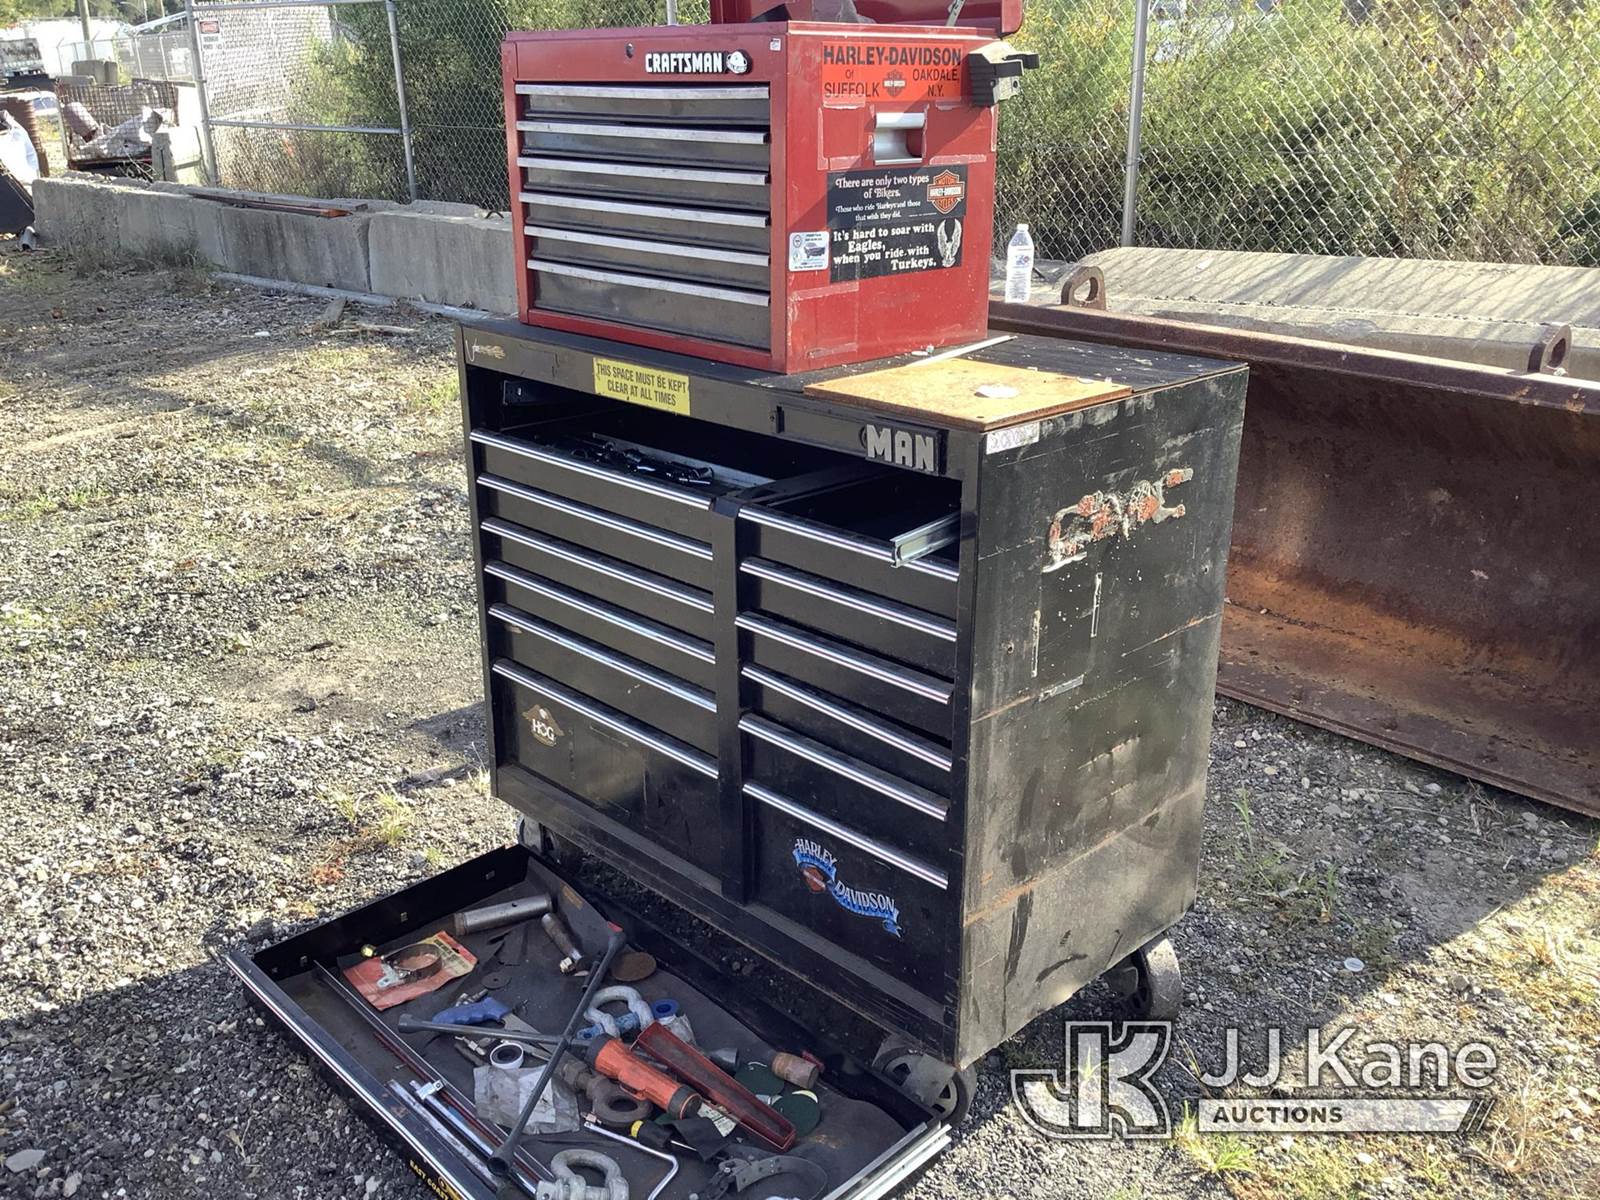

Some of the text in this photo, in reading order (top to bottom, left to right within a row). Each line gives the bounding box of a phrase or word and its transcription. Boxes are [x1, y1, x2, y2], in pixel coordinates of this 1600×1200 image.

[645, 52, 723, 73] CRAFTSMAN
[823, 45, 961, 66] HARLEY-DAVIDSON
[824, 82, 880, 98] SUFFOLK
[927, 84, 945, 97] N.Y.
[835, 175, 929, 188] There are only two types
[863, 188, 873, 199] of
[880, 212, 891, 220] they
[833, 223, 935, 242] It's hard to soar with
[833, 253, 860, 266] when
[863, 251, 881, 263] you
[907, 245, 930, 256] with
[848, 240, 886, 254] Eagles,
[890, 256, 937, 271] Turkeys.
[597, 363, 686, 393] THIS SPACE MUST BE KEPT
[607, 379, 677, 406] CLEAR AT ALL TIMES
[866, 423, 934, 472] MAN
[531, 718, 555, 741] HOG
[794, 838, 838, 865] HARLEY
[834, 880, 896, 912] DAVIDSON
